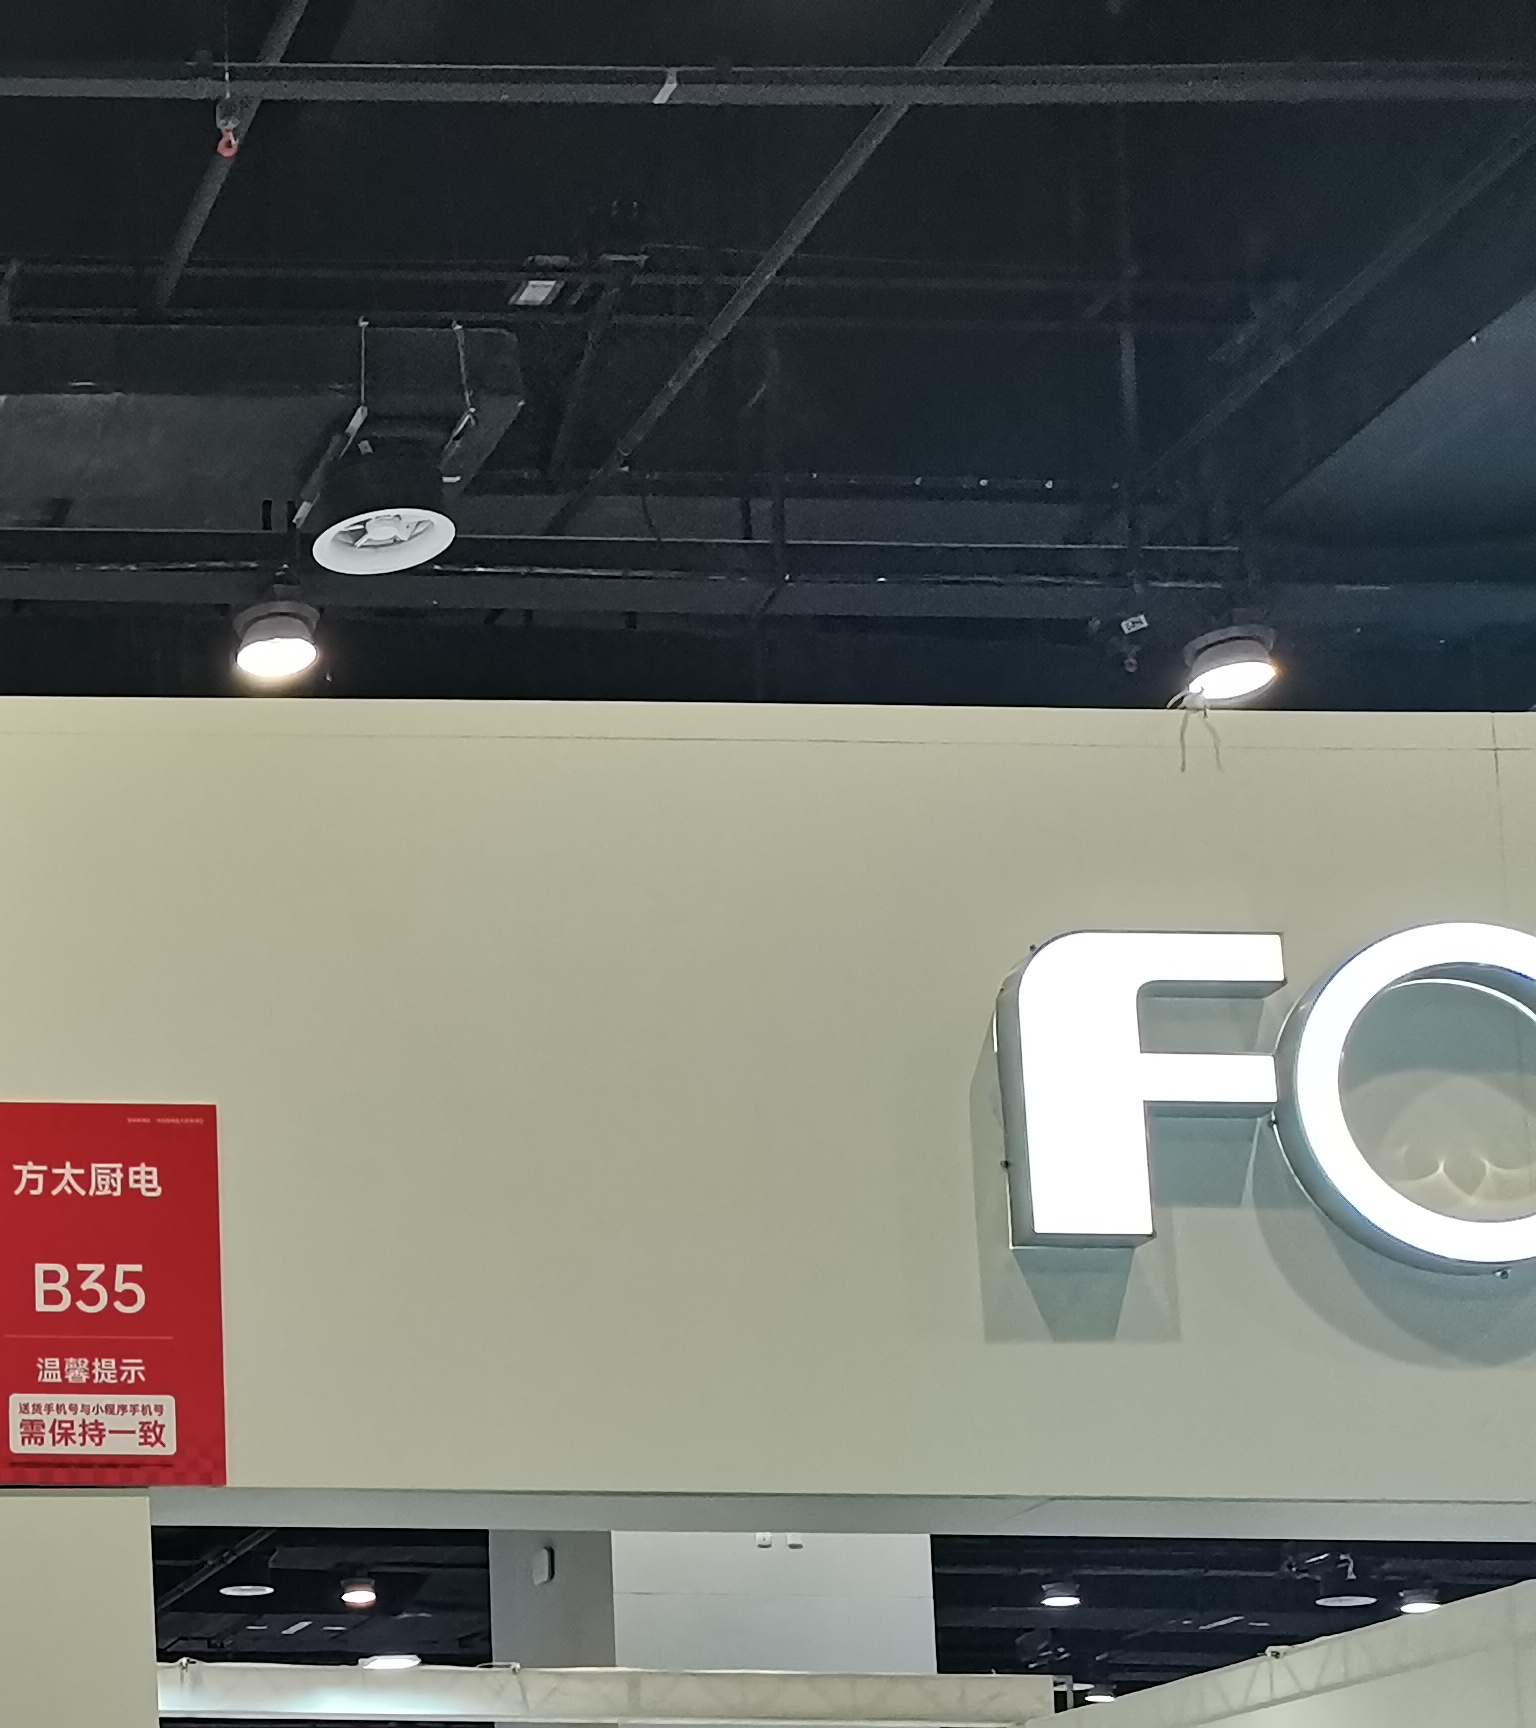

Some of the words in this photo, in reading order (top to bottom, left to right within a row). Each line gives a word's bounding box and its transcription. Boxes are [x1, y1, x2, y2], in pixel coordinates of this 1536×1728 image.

[12, 1160, 162, 1198] 方太厨电
[34, 1263, 146, 1314] B35
[36, 1357, 147, 1385] 温馨提示
[19, 1418, 167, 1449] 需保持一致
